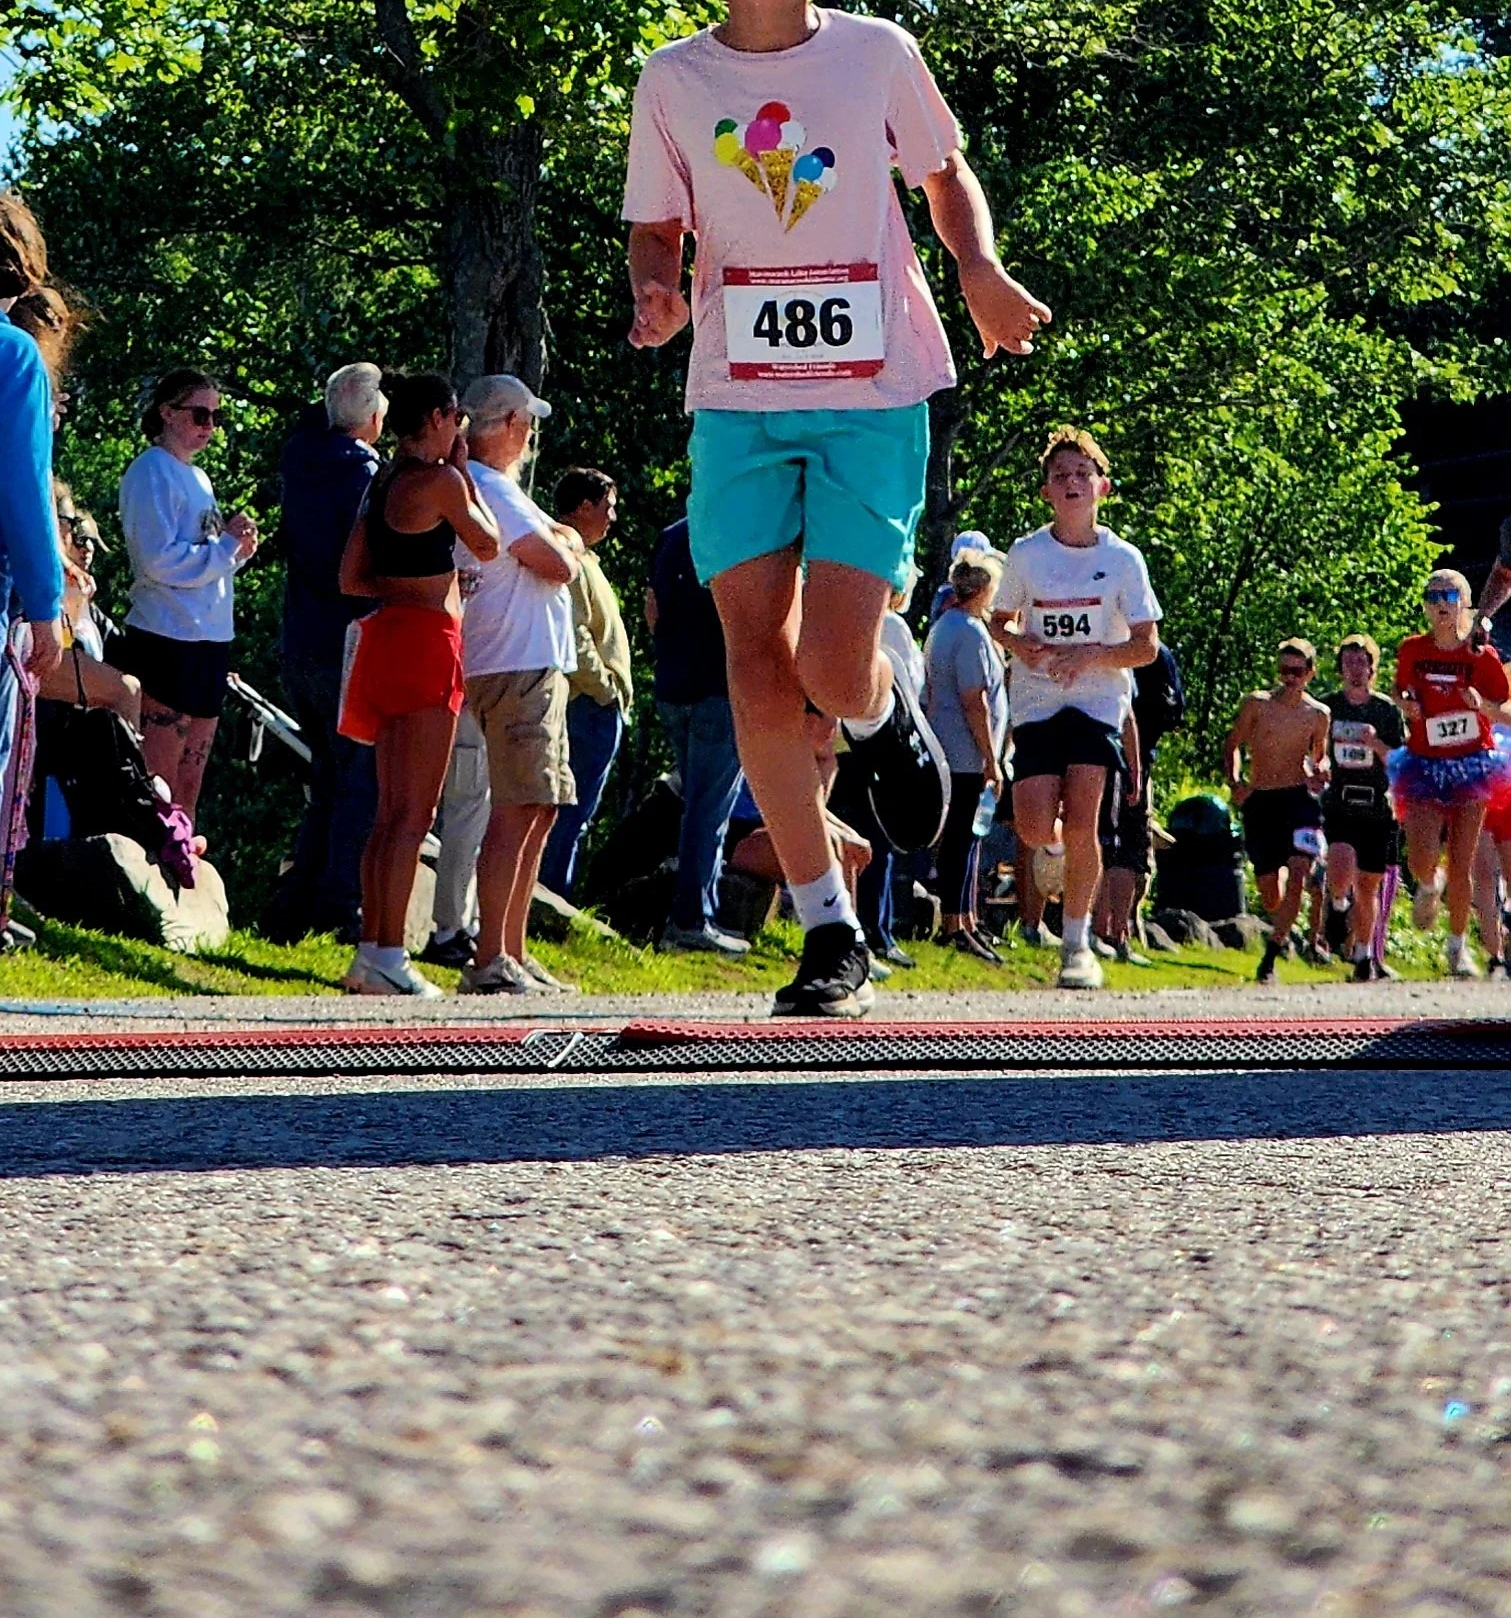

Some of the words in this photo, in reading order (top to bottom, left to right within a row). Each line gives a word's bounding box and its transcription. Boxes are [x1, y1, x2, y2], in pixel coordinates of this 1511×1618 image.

[753, 297, 853, 348] 486
[1043, 613, 1091, 638] 594
[1437, 718, 1467, 737] 327
